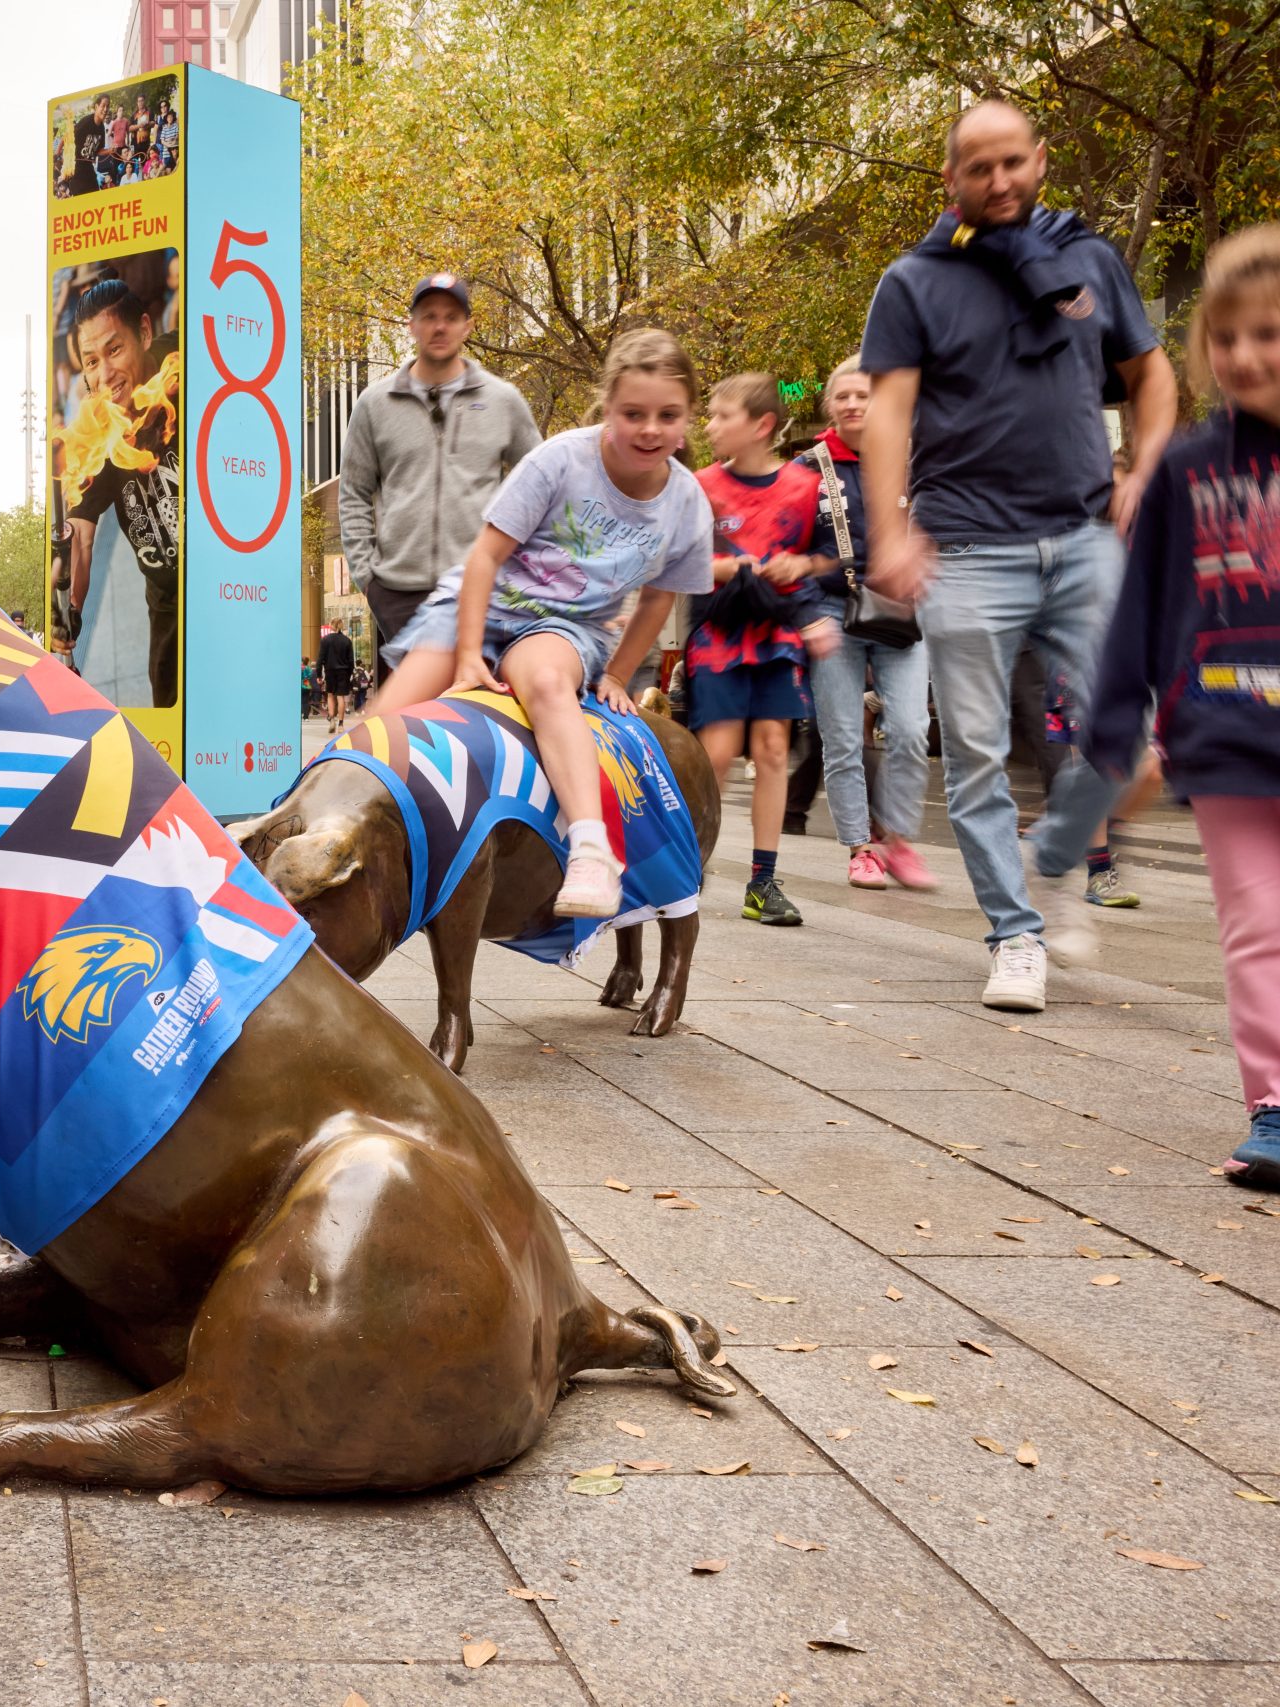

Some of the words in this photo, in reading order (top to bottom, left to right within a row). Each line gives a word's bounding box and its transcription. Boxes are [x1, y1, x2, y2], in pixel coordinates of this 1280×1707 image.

[53, 204, 105, 234] ENJOY
[108, 199, 142, 221] THE
[53, 225, 129, 255] FESTIVAL
[132, 215, 168, 240] FUN
[226, 314, 263, 337] FIFTY
[222, 455, 266, 478] YEARS
[219, 582, 268, 603] ICONIC
[195, 751, 229, 766] ONLY
[257, 741, 292, 757] Rundle
[257, 758, 279, 773] Mall
[132, 1007, 189, 1071] GATHER
[172, 958, 217, 1017] ROUND
[152, 1066, 162, 1077] A
[158, 1020, 195, 1068] FESTIVAL
[192, 1003, 203, 1020] OF
